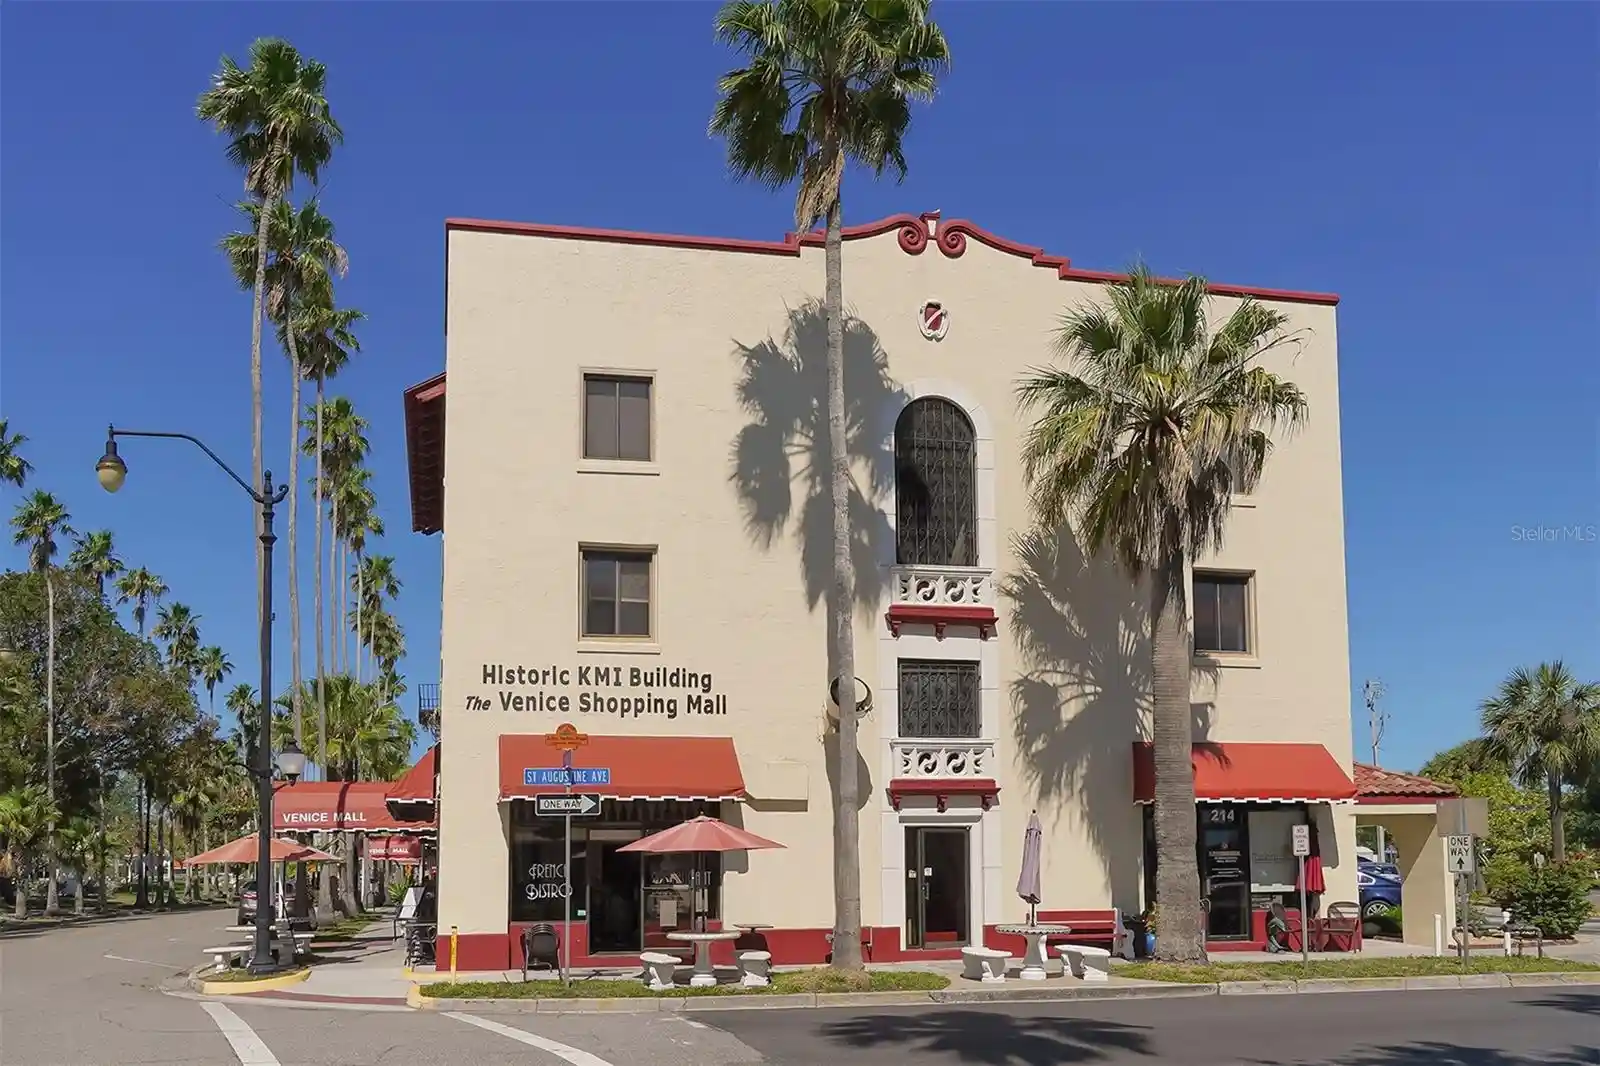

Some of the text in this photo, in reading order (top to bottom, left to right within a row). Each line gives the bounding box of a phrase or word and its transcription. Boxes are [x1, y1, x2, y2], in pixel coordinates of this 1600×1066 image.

[482, 664, 712, 693] Historic KMI Building
[465, 691, 727, 719] The Venice Shopping Mall
[527, 771, 607, 783] ST AUGUSINE AVE
[543, 799, 582, 809] ONE WAY
[283, 811, 367, 823] VENICE MALL
[1210, 809, 1235, 822] 214
[1450, 836, 1469, 846] ONE
[1450, 847, 1470, 857] WAY
[525, 883, 573, 900] BISTRO
